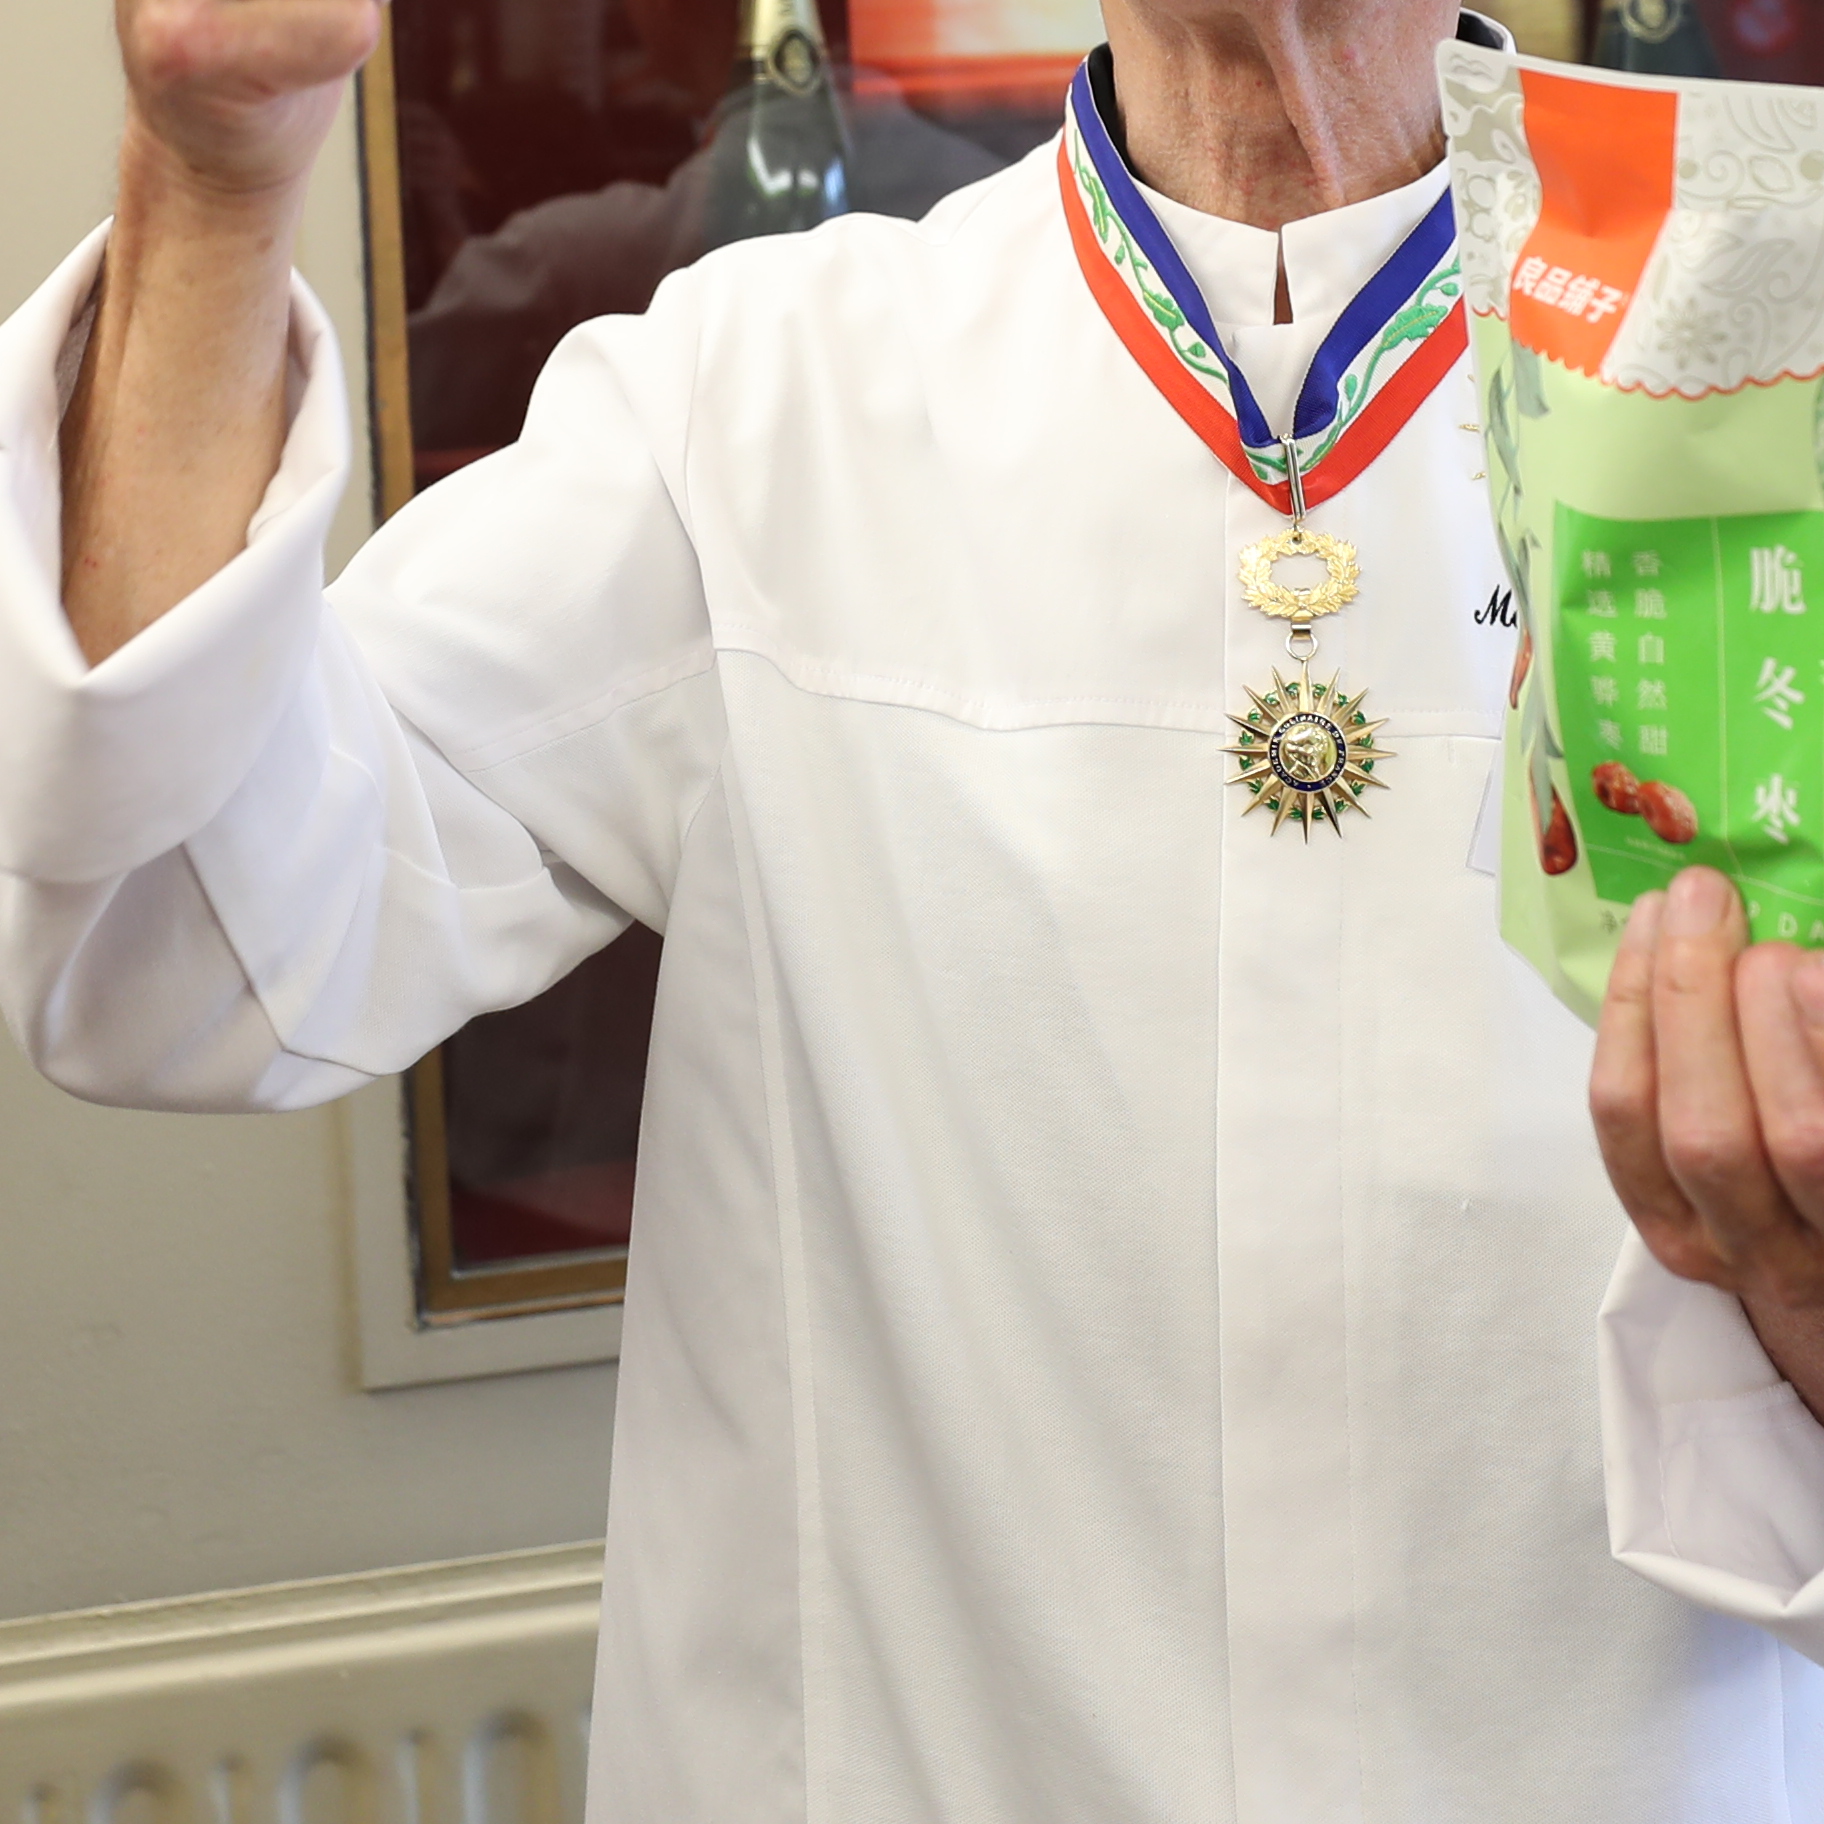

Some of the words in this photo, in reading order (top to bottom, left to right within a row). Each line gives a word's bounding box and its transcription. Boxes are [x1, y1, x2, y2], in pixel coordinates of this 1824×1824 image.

[1513, 256, 1624, 324] 良品铺子
[1749, 543, 1807, 845] 脆冬枣
